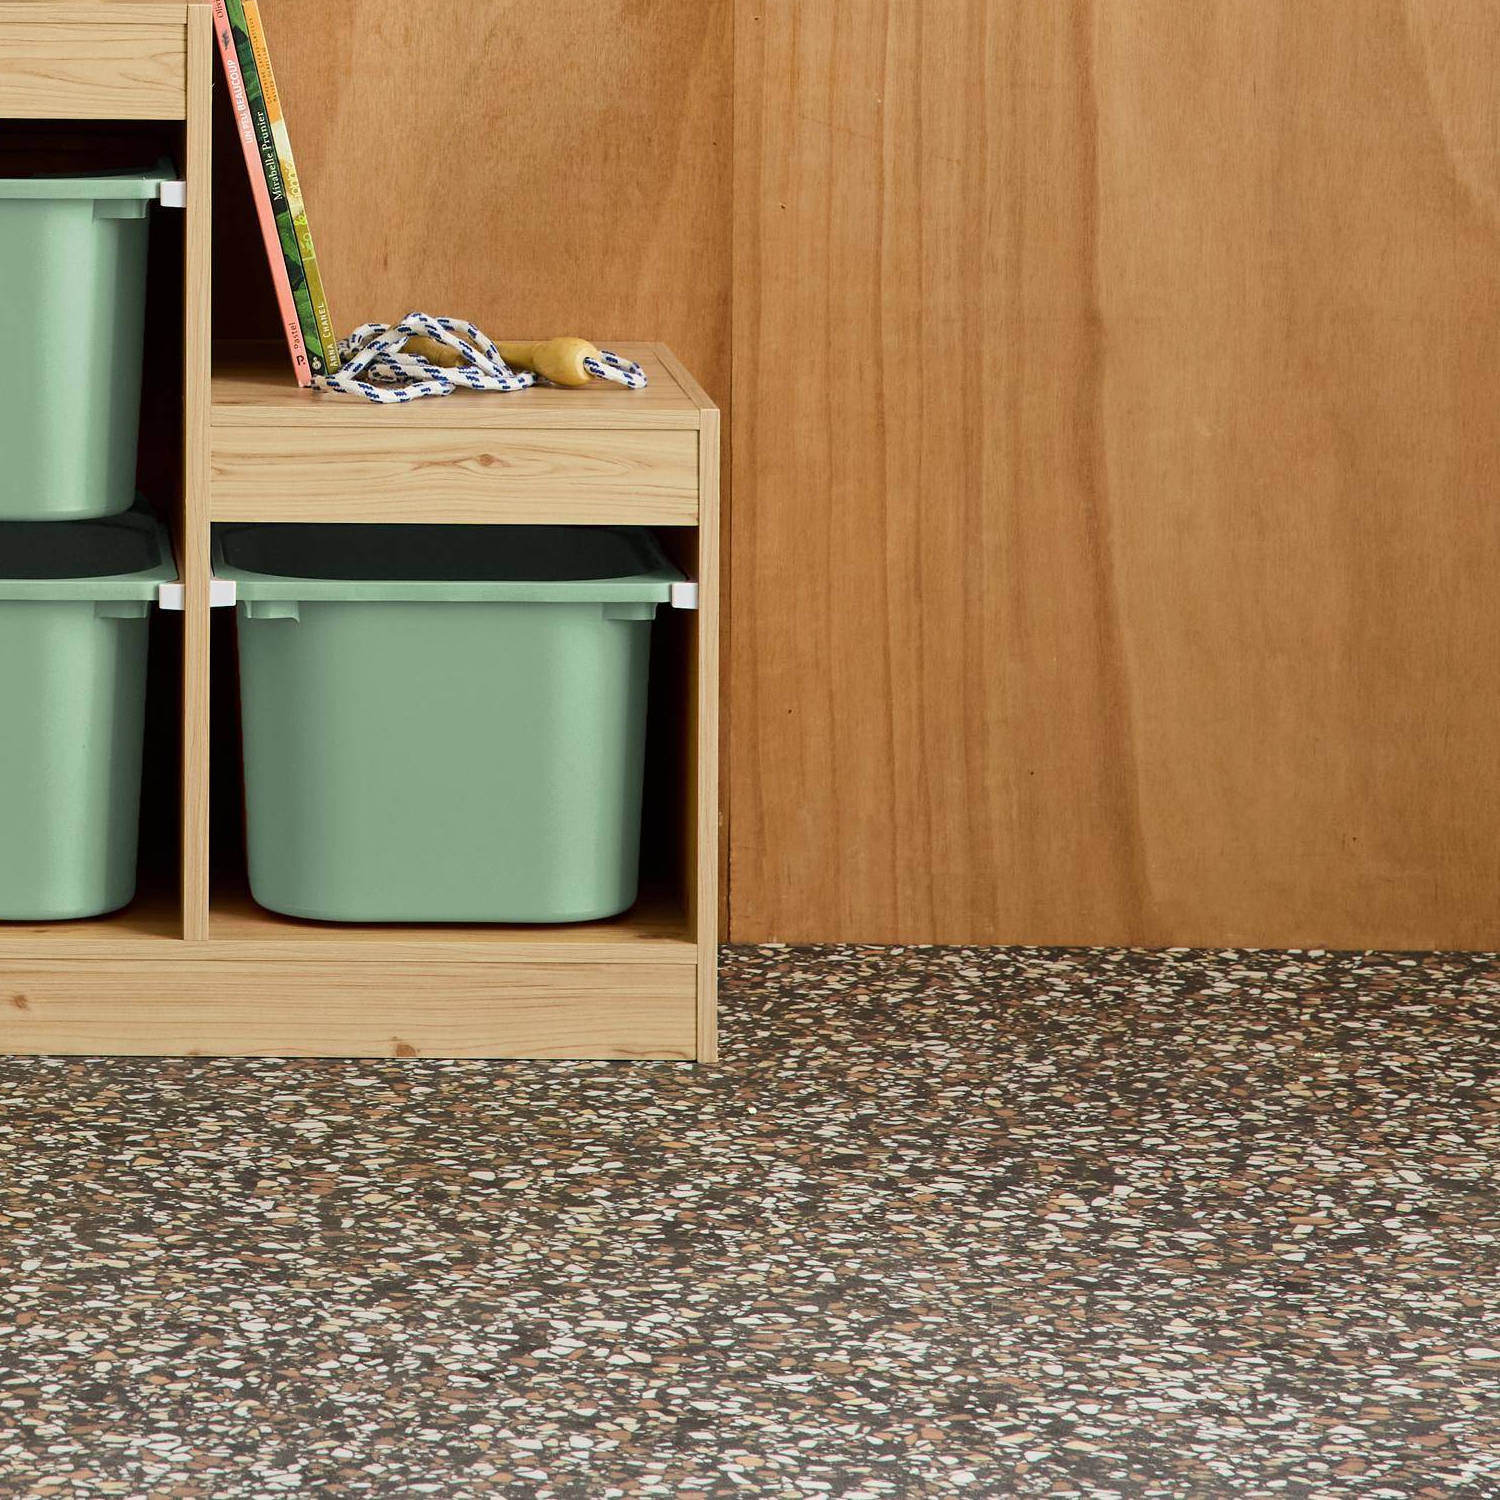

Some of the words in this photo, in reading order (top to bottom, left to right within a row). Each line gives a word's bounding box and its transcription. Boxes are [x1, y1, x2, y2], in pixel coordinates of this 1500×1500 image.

[228, 59, 247, 110] BEAUCOUP
[256, 111, 272, 150] Prunier
[263, 151, 283, 200] Mirabelle
